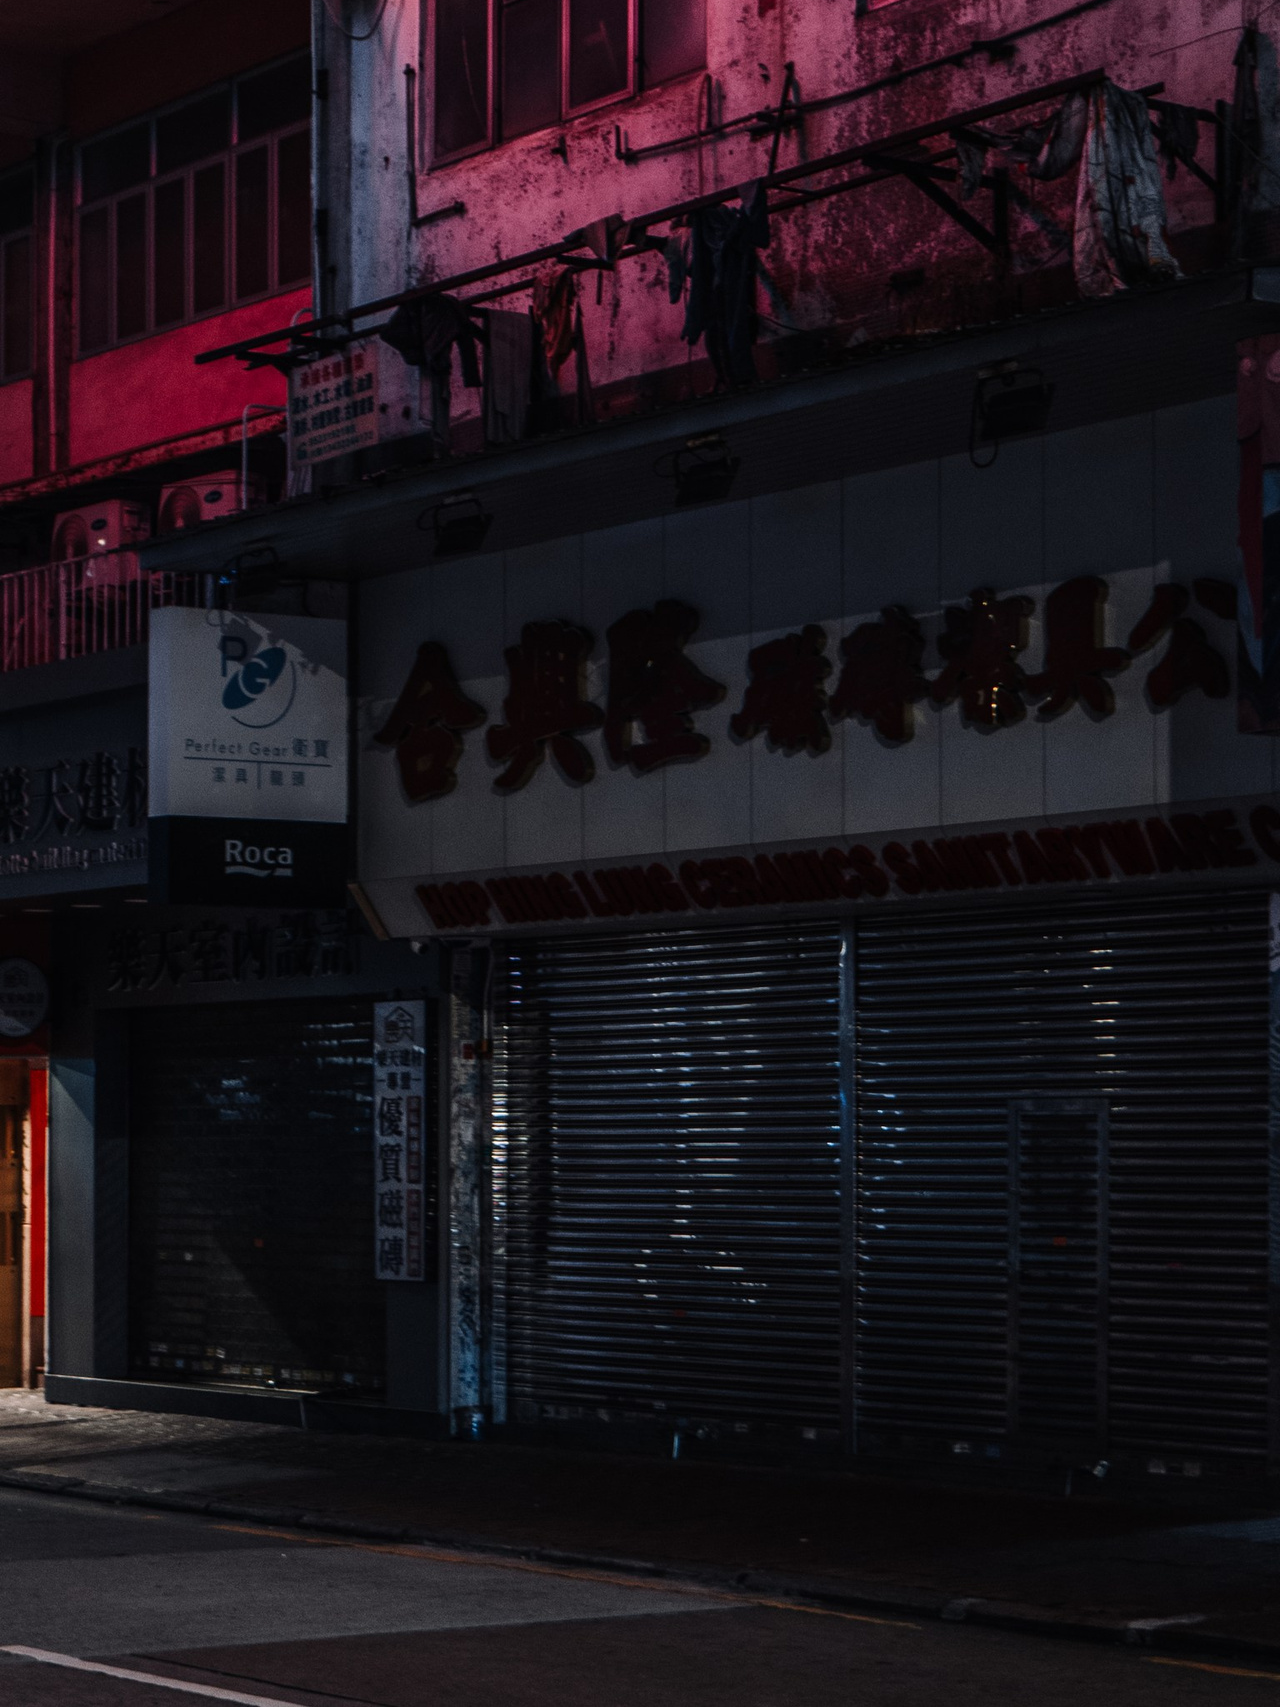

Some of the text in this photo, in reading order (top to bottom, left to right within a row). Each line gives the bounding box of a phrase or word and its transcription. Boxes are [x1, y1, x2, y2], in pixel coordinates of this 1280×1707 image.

[184, 737, 243, 755] Perfect
[249, 741, 289, 758] Gear
[224, 838, 293, 866] Roca
[416, 880, 491, 930] HOP
[485, 871, 588, 925] HING
[572, 862, 691, 917] LUNG
[679, 843, 889, 911] CERAMICS
[882, 809, 1258, 895] SANITARYWARE
